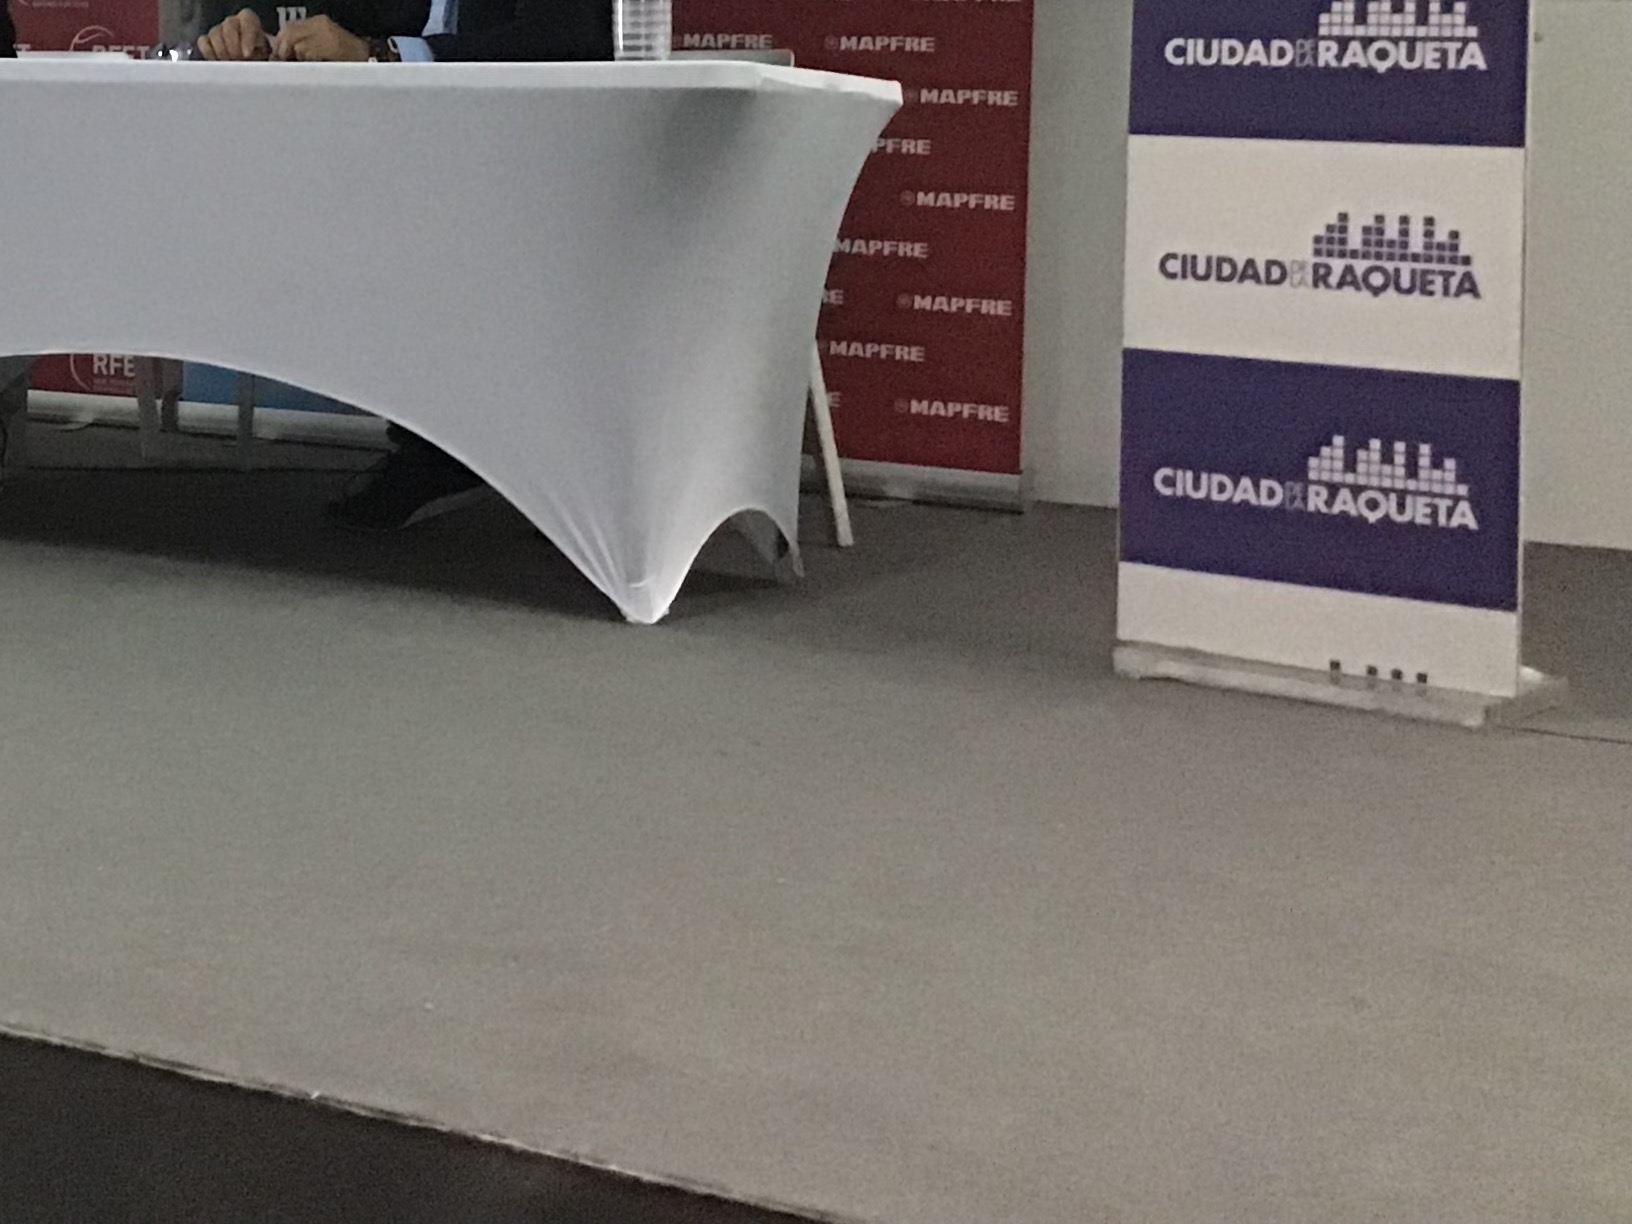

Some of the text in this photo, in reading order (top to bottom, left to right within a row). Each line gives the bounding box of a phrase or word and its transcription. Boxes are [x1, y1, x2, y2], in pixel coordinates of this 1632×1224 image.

[684, 33, 773, 49] MAPFRE
[840, 36, 936, 53] MAPFRE
[1165, 38, 1294, 66] CIUDAD
[1318, 39, 1487, 74] RAQUETA
[920, 89, 1018, 107] MAPFRE
[870, 138, 931, 155] PFRE
[916, 191, 1015, 211] MAPFRE
[1158, 252, 1288, 286] CIUDAD
[1311, 262, 1481, 299] RAQUETA
[913, 295, 1012, 316] MAPFRE
[830, 340, 926, 362] MAPFRE
[92, 353, 135, 377] RFE
[910, 399, 1009, 423] MAPFRE
[1153, 468, 1283, 508] CIUDAD
[1306, 485, 1478, 530] RAQUETA
